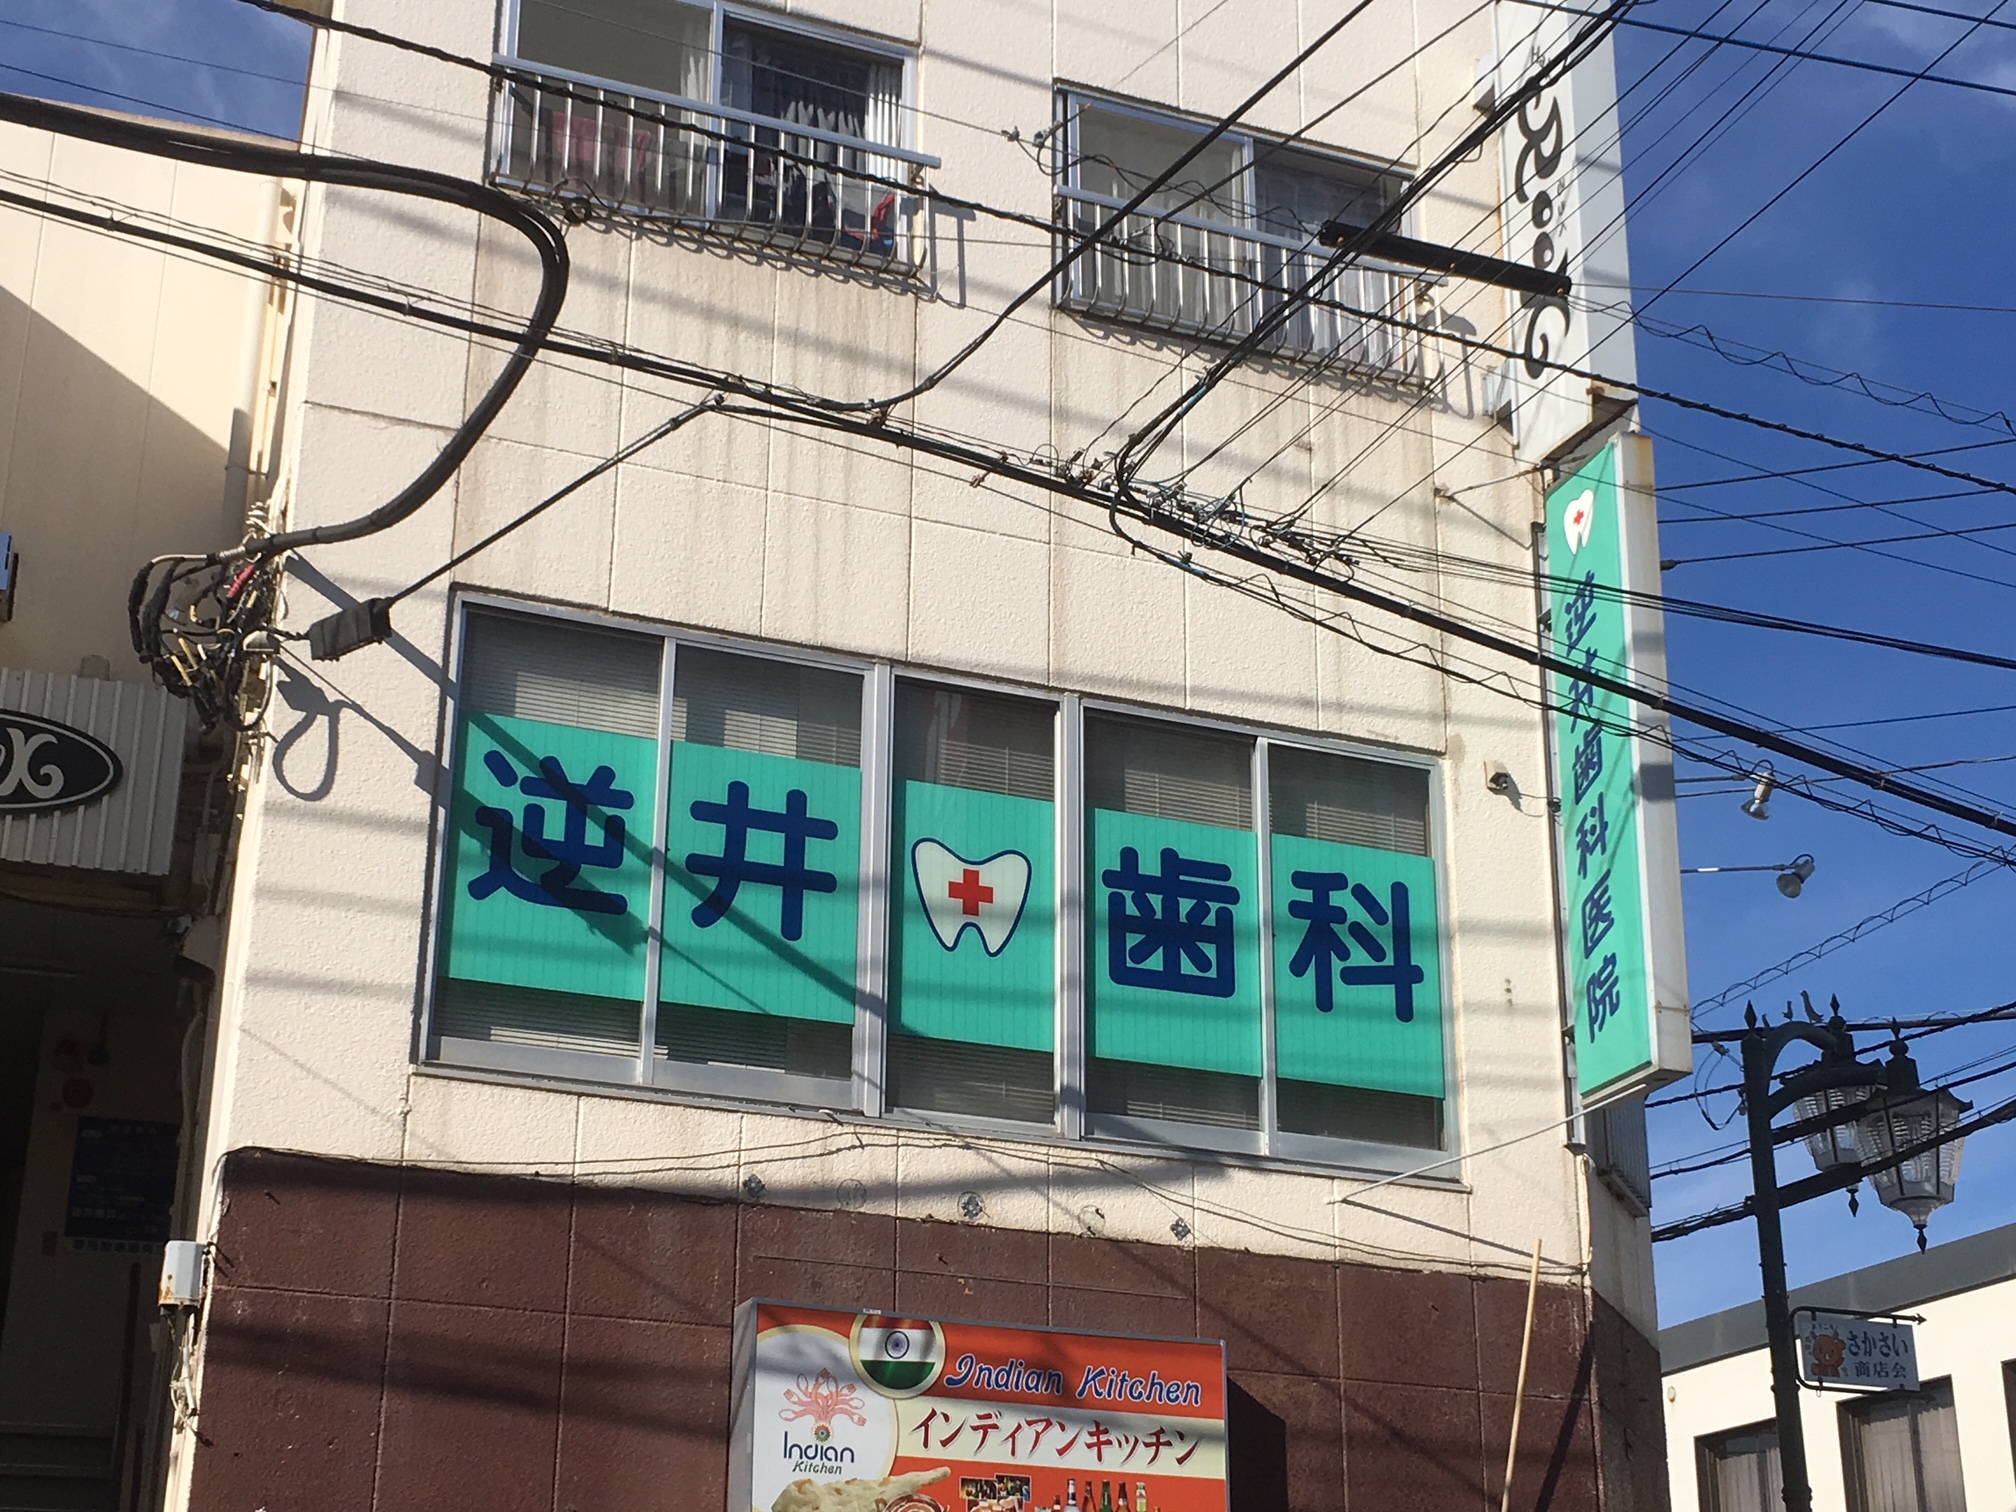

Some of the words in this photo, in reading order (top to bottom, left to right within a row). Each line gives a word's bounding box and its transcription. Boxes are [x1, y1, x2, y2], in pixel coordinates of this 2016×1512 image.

[1564, 571, 1621, 1044] 逆井歯科医院
[467, 750, 838, 941] 逆井
[1101, 846, 1425, 1023] 歯科
[1848, 1330, 1909, 1358] さかさい
[944, 1353, 1064, 1396] Indian
[1076, 1365, 1203, 1406] Kitchen
[1855, 1361, 1907, 1379] 商店会
[783, 1431, 855, 1463] Indian
[908, 1406, 1203, 1468] インディアンキッチン
[792, 1460, 843, 1475] Kitchen
